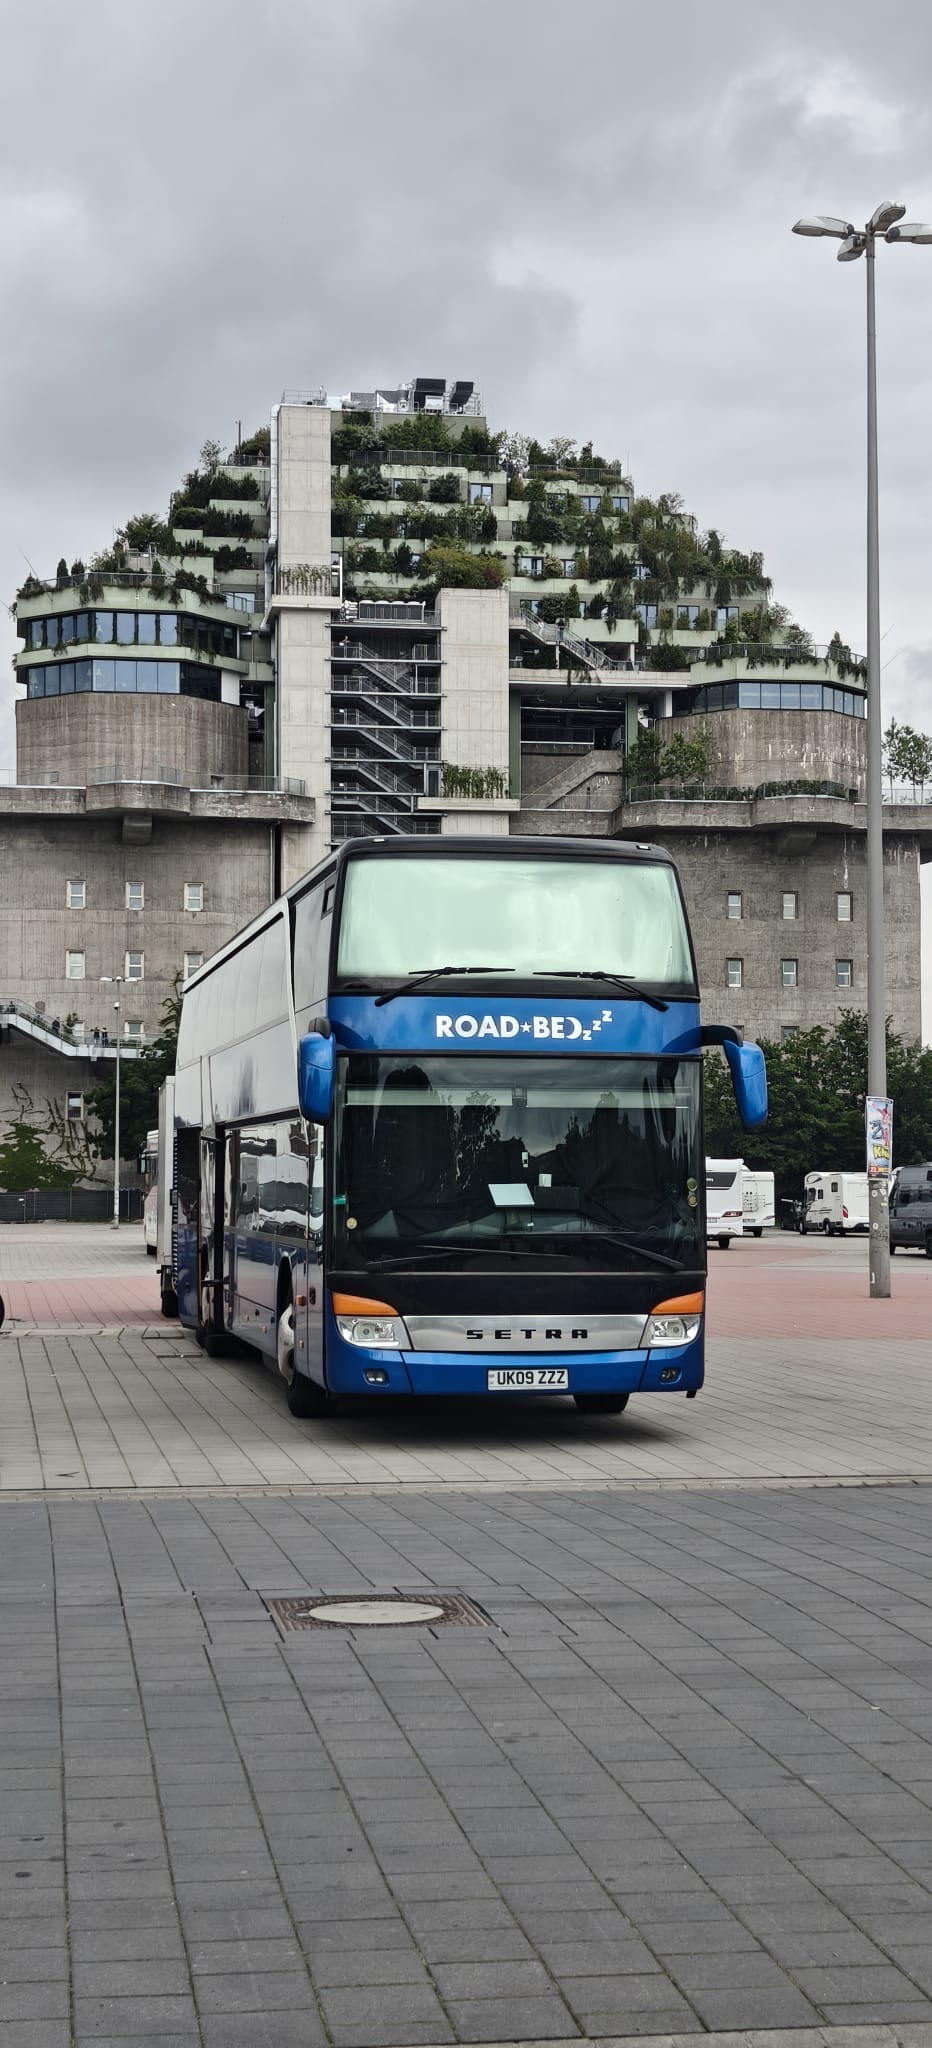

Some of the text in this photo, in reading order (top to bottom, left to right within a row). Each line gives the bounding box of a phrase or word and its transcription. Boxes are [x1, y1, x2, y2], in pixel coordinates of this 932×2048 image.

[435, 1015, 520, 1038] ROAD
[466, 1329, 588, 1340] SETRA
[497, 1370, 565, 1385] UK09 ZZZ
